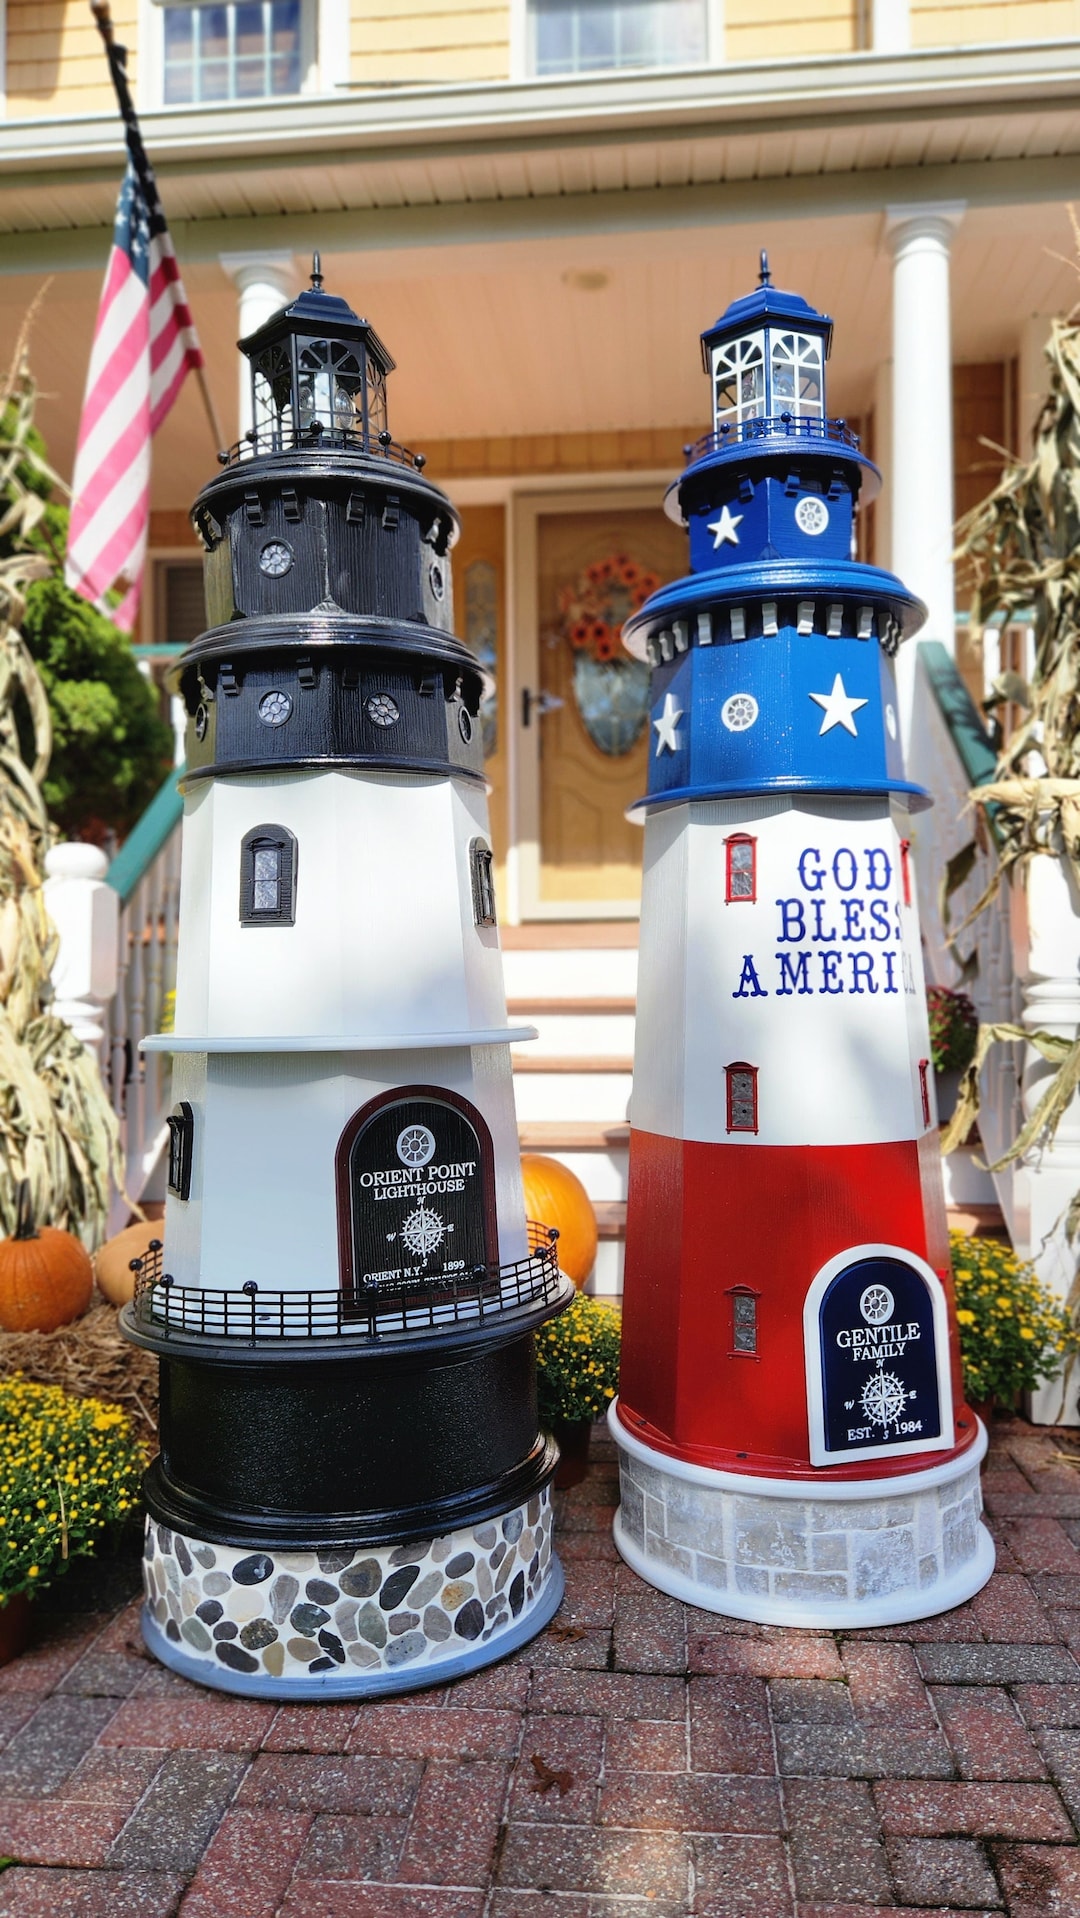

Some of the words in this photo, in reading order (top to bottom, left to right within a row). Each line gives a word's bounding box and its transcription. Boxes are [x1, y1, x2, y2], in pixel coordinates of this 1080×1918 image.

[797, 848, 892, 891] GOD
[360, 1166, 424, 1187] ORIENT
[428, 1161, 477, 1180] POINT
[373, 1179, 466, 1201] LIGHTHOUSE
[417, 1196, 426, 1205] N
[386, 1232, 397, 1242] W
[363, 1268, 402, 1284] ORIENT
[403, 1265, 423, 1278] N.Y.
[442, 1260, 465, 1272] 1899
[421, 1258, 428, 1267] S
[836, 1322, 921, 1349] GENTILE
[852, 1342, 906, 1362] FAMILY
[876, 1358, 885, 1368] N
[844, 1400, 855, 1410] W
[847, 1426, 875, 1441] EST.
[895, 1420, 923, 1435] 1984
[883, 1429, 889, 1440] S
